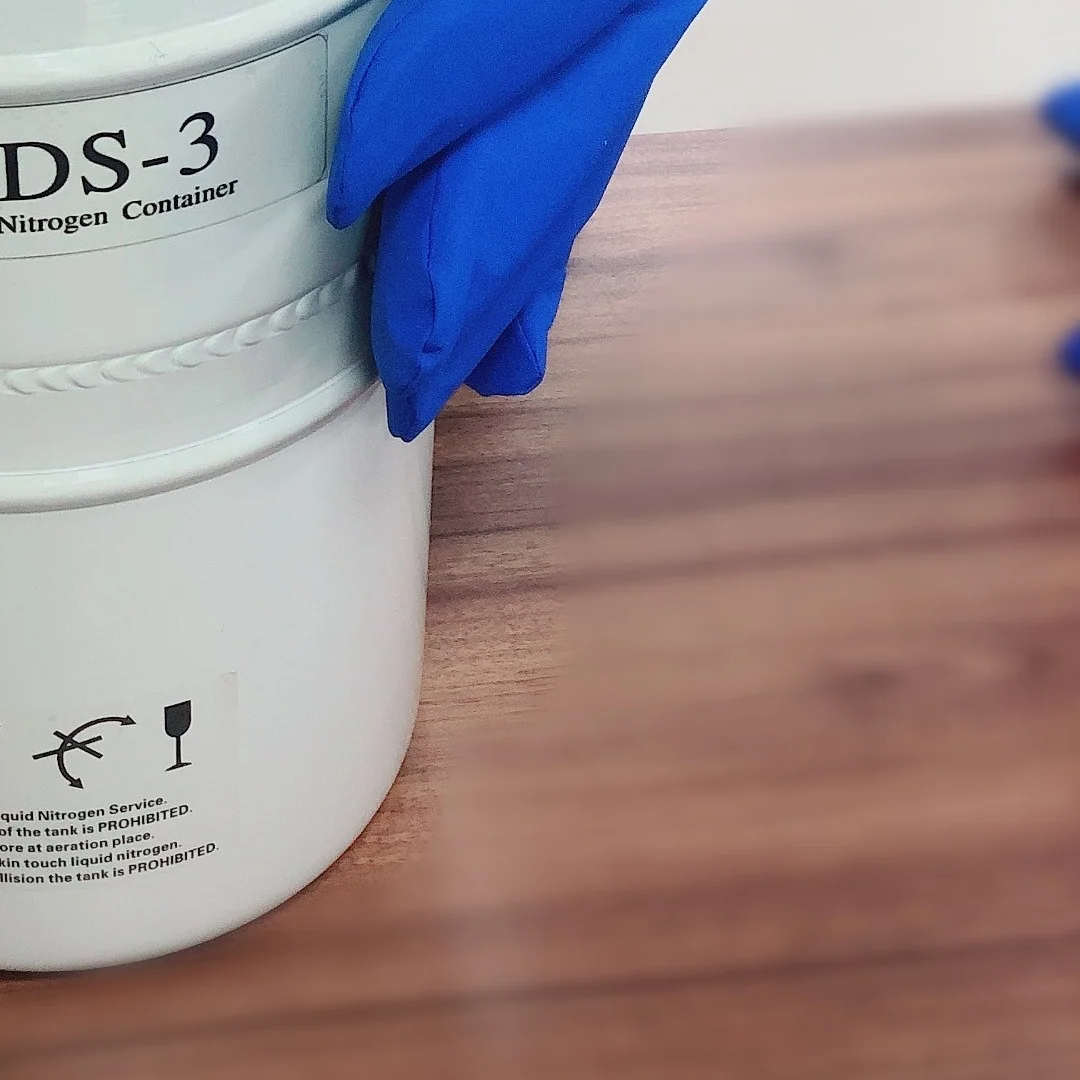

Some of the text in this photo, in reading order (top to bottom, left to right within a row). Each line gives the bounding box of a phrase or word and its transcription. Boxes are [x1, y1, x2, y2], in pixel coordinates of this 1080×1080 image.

[122, 179, 238, 221] Container
[16, 827, 41, 837] the
[45, 825, 78, 836] tank
[82, 824, 94, 834] is
[98, 804, 193, 832] PROHIBITED.
[38, 808, 105, 821] Nitrogen
[109, 796, 167, 815] Service.
[24, 855, 67, 868] touch
[70, 853, 113, 867] liquid
[117, 840, 182, 861] nitrogen.
[28, 842, 42, 852] at
[46, 839, 108, 852] aeration
[112, 831, 155, 851] place.
[49, 873, 73, 883] the
[76, 869, 109, 881] tank
[113, 868, 125, 878] is
[129, 842, 219, 875] PROHIBITED.
